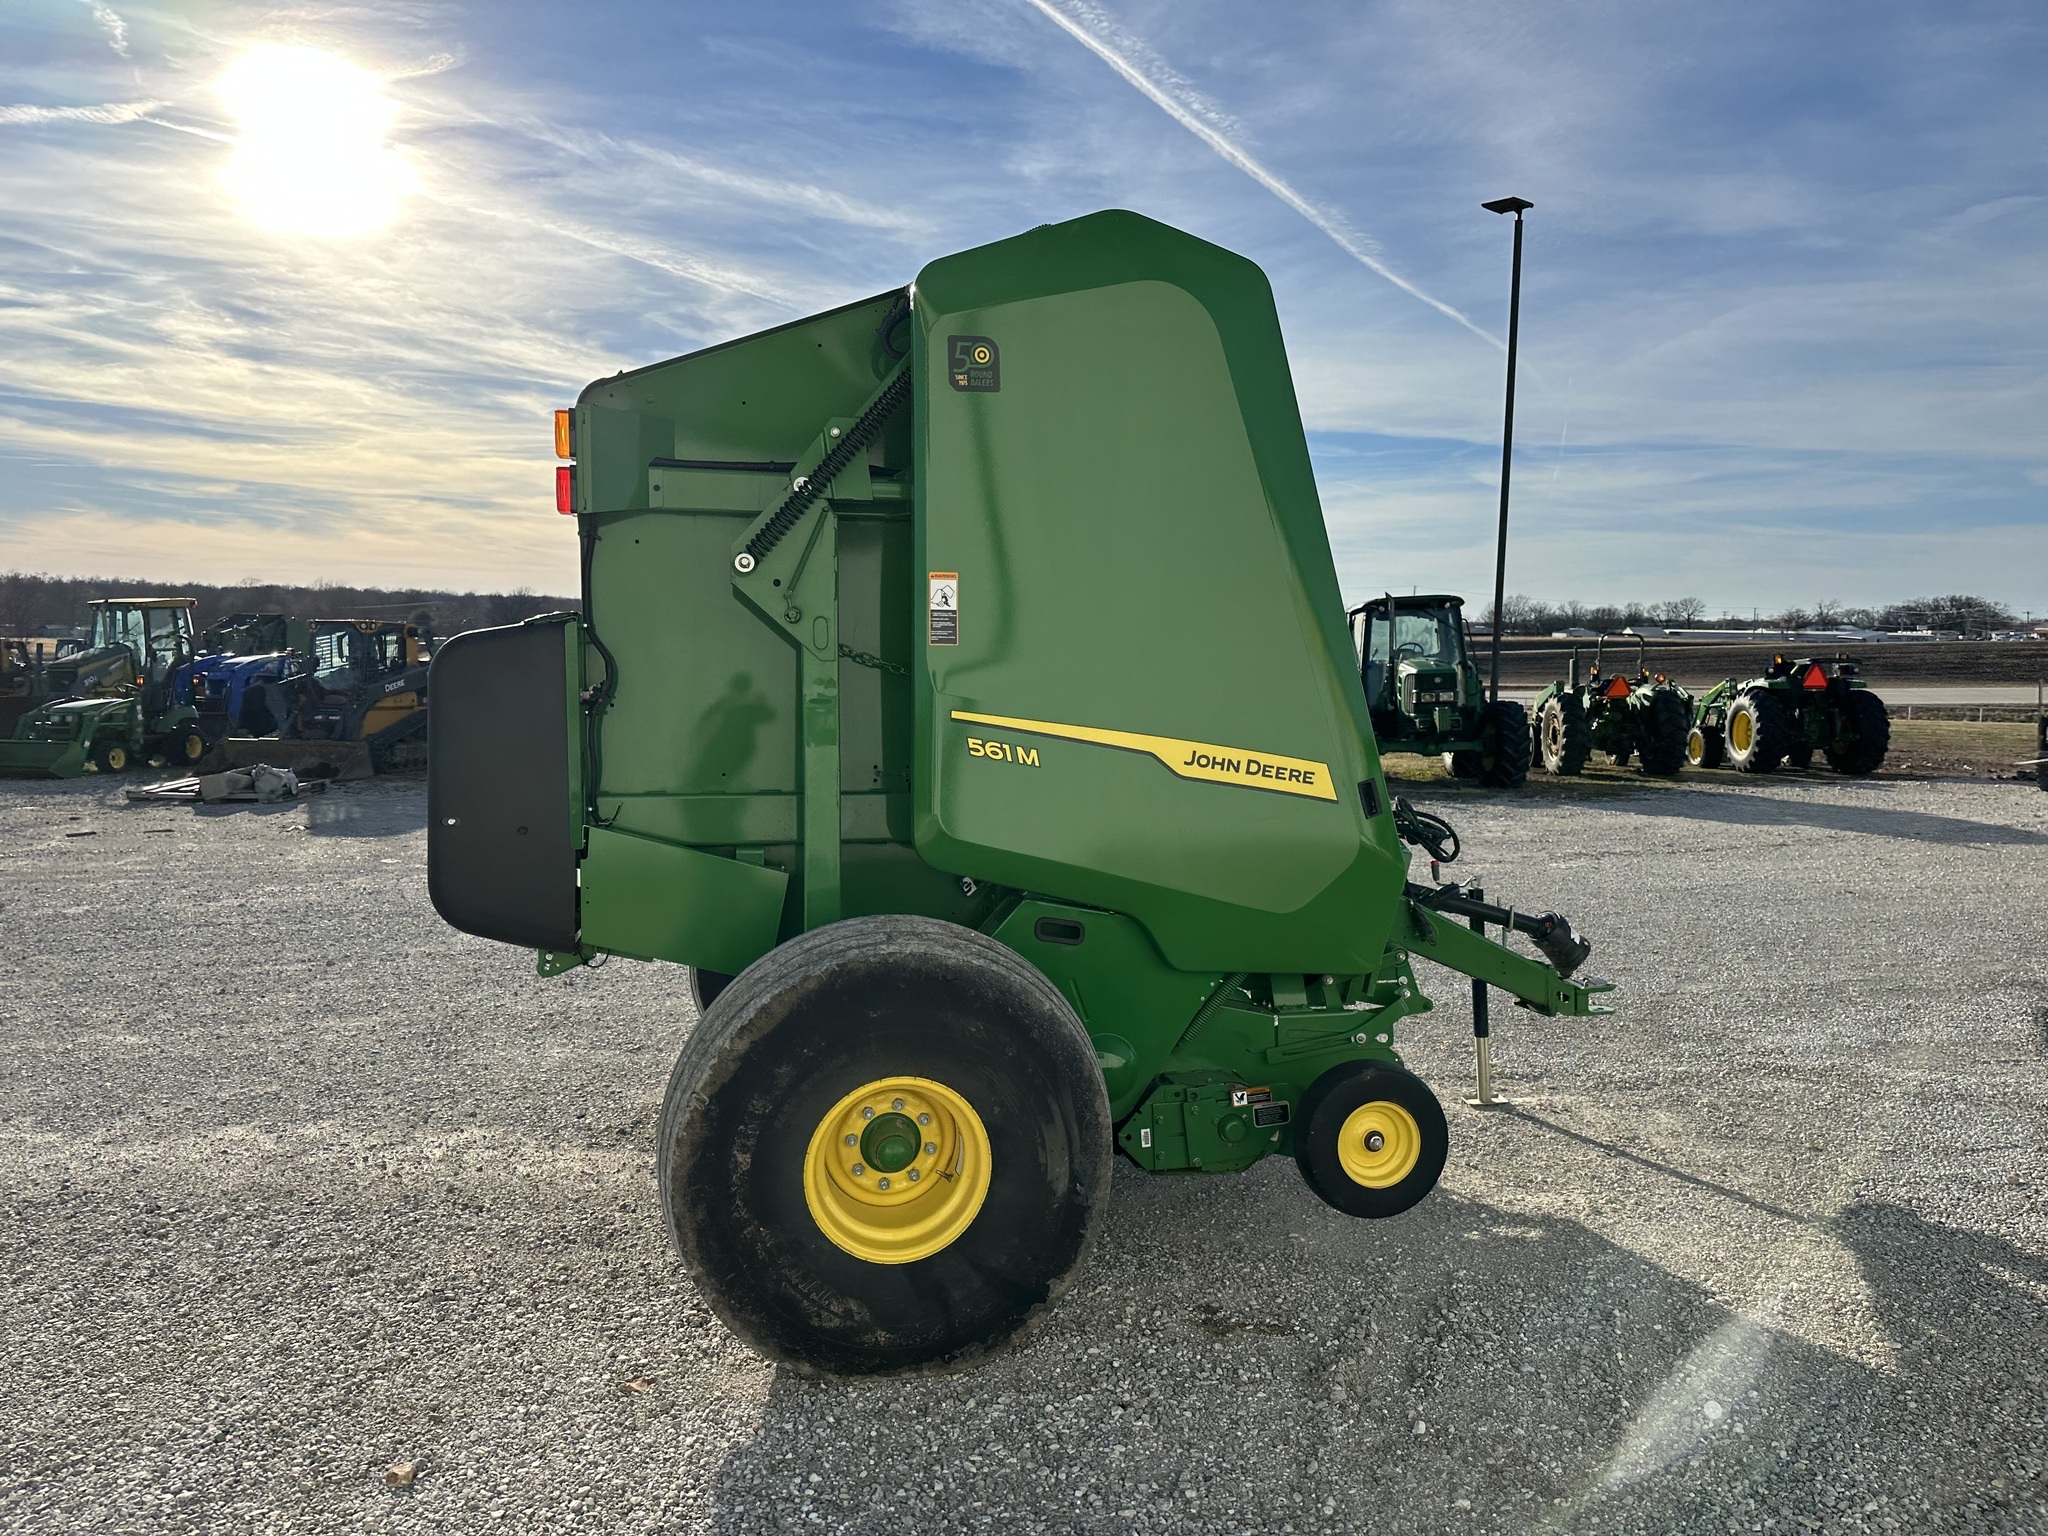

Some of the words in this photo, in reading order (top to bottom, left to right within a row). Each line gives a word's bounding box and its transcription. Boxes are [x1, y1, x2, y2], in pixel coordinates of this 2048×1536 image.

[384, 679, 405, 692] DEERE
[1183, 750, 1241, 774] JOHN
[1245, 758, 1316, 785] DEERE
